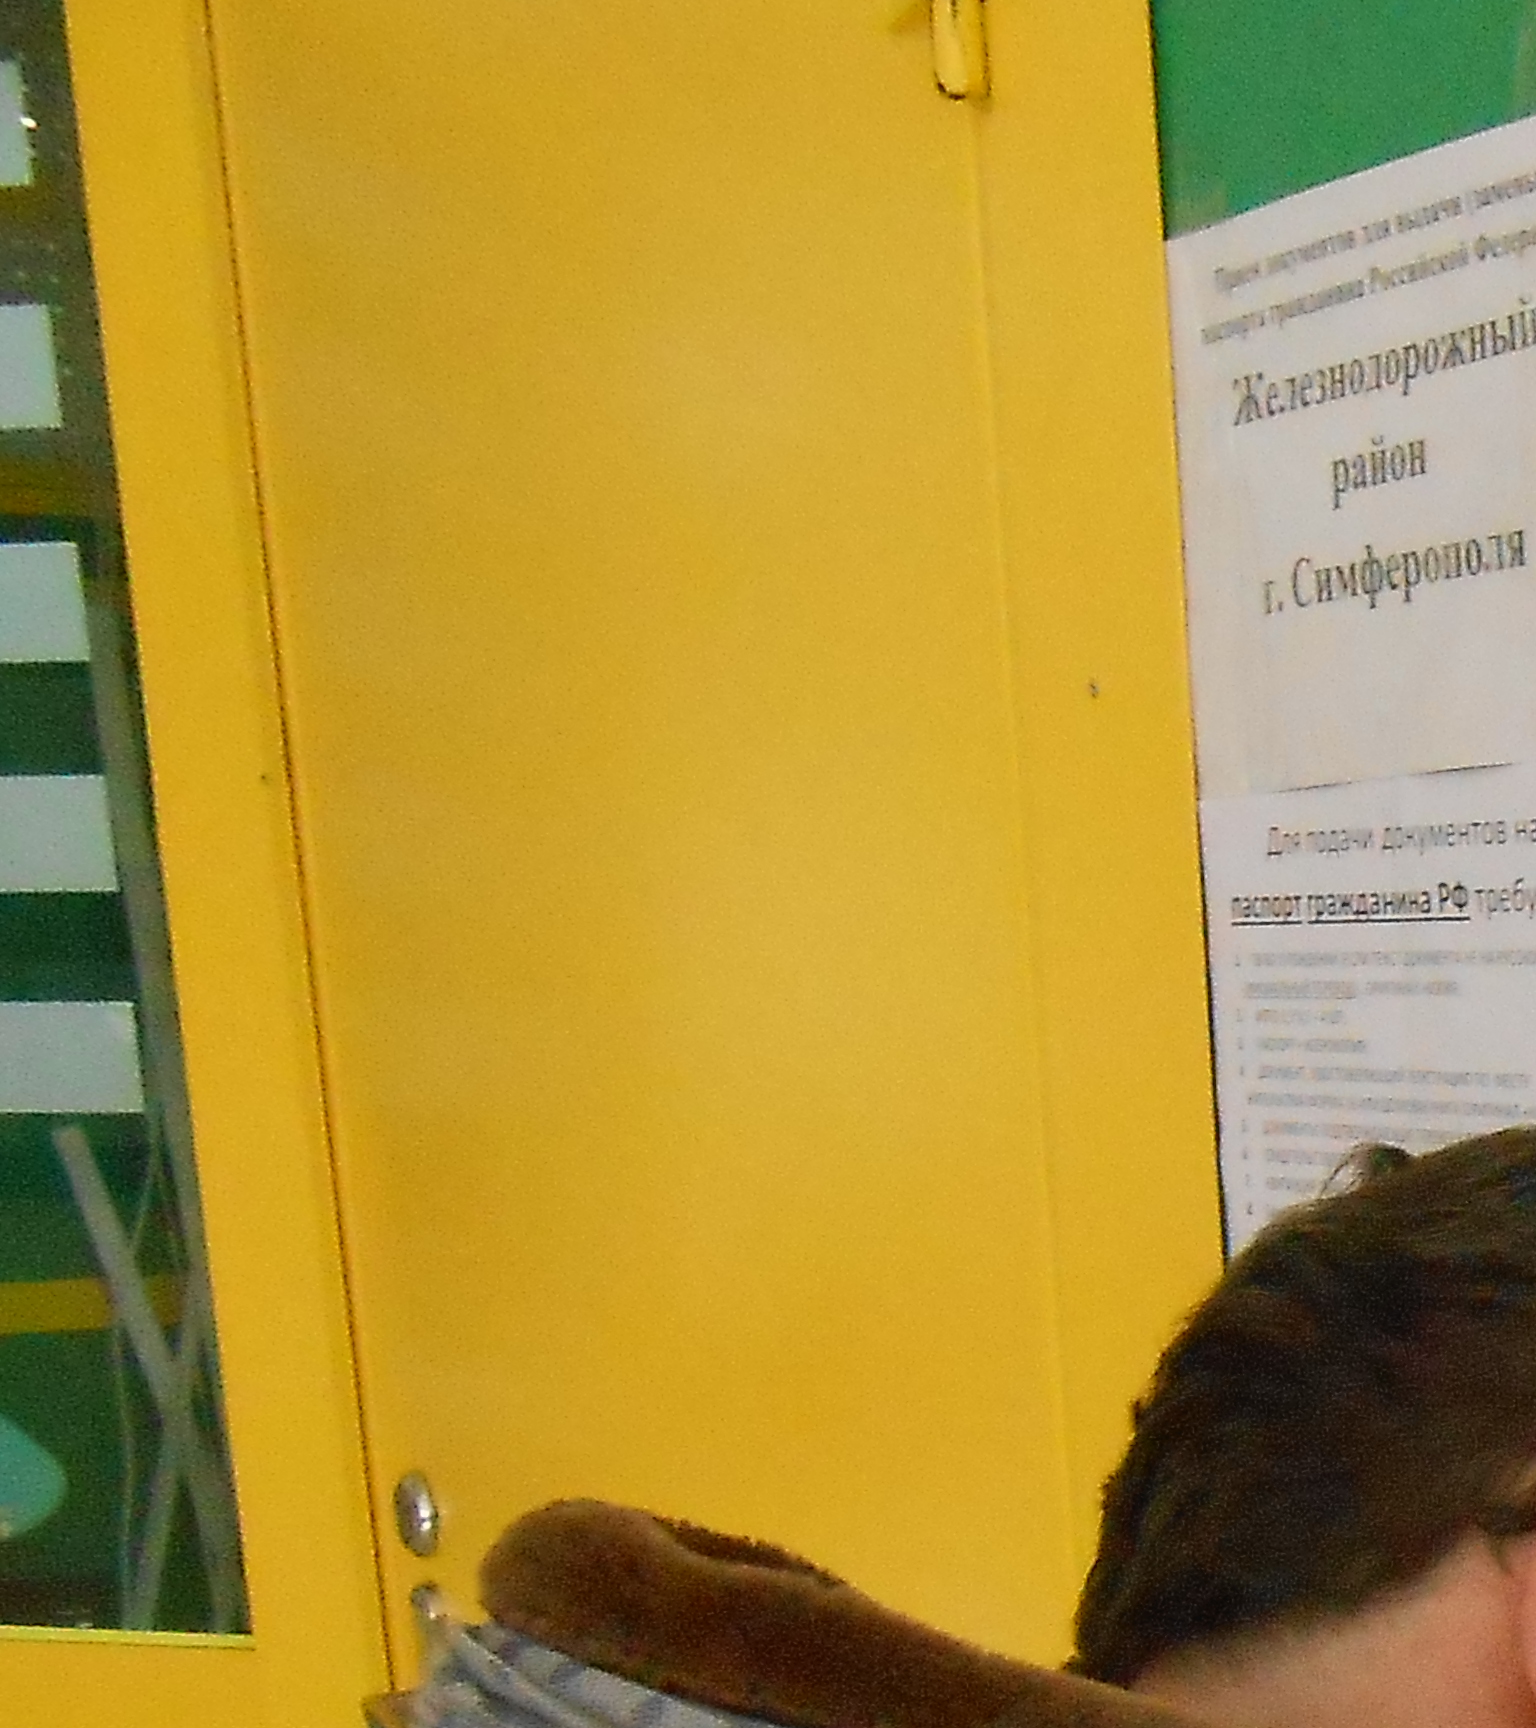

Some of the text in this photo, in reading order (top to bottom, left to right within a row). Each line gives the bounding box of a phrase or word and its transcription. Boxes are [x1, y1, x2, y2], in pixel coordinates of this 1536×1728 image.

[1330, 434, 1428, 511] район
[1263, 529, 1529, 615] г. Симферополя
[1267, 826, 1301, 857] Для
[1305, 825, 1373, 857] подачи
[1381, 820, 1508, 856] документов
[1230, 893, 1303, 923] паспорт
[1306, 889, 1431, 922] гражданина
[1437, 880, 1469, 915] РФ
